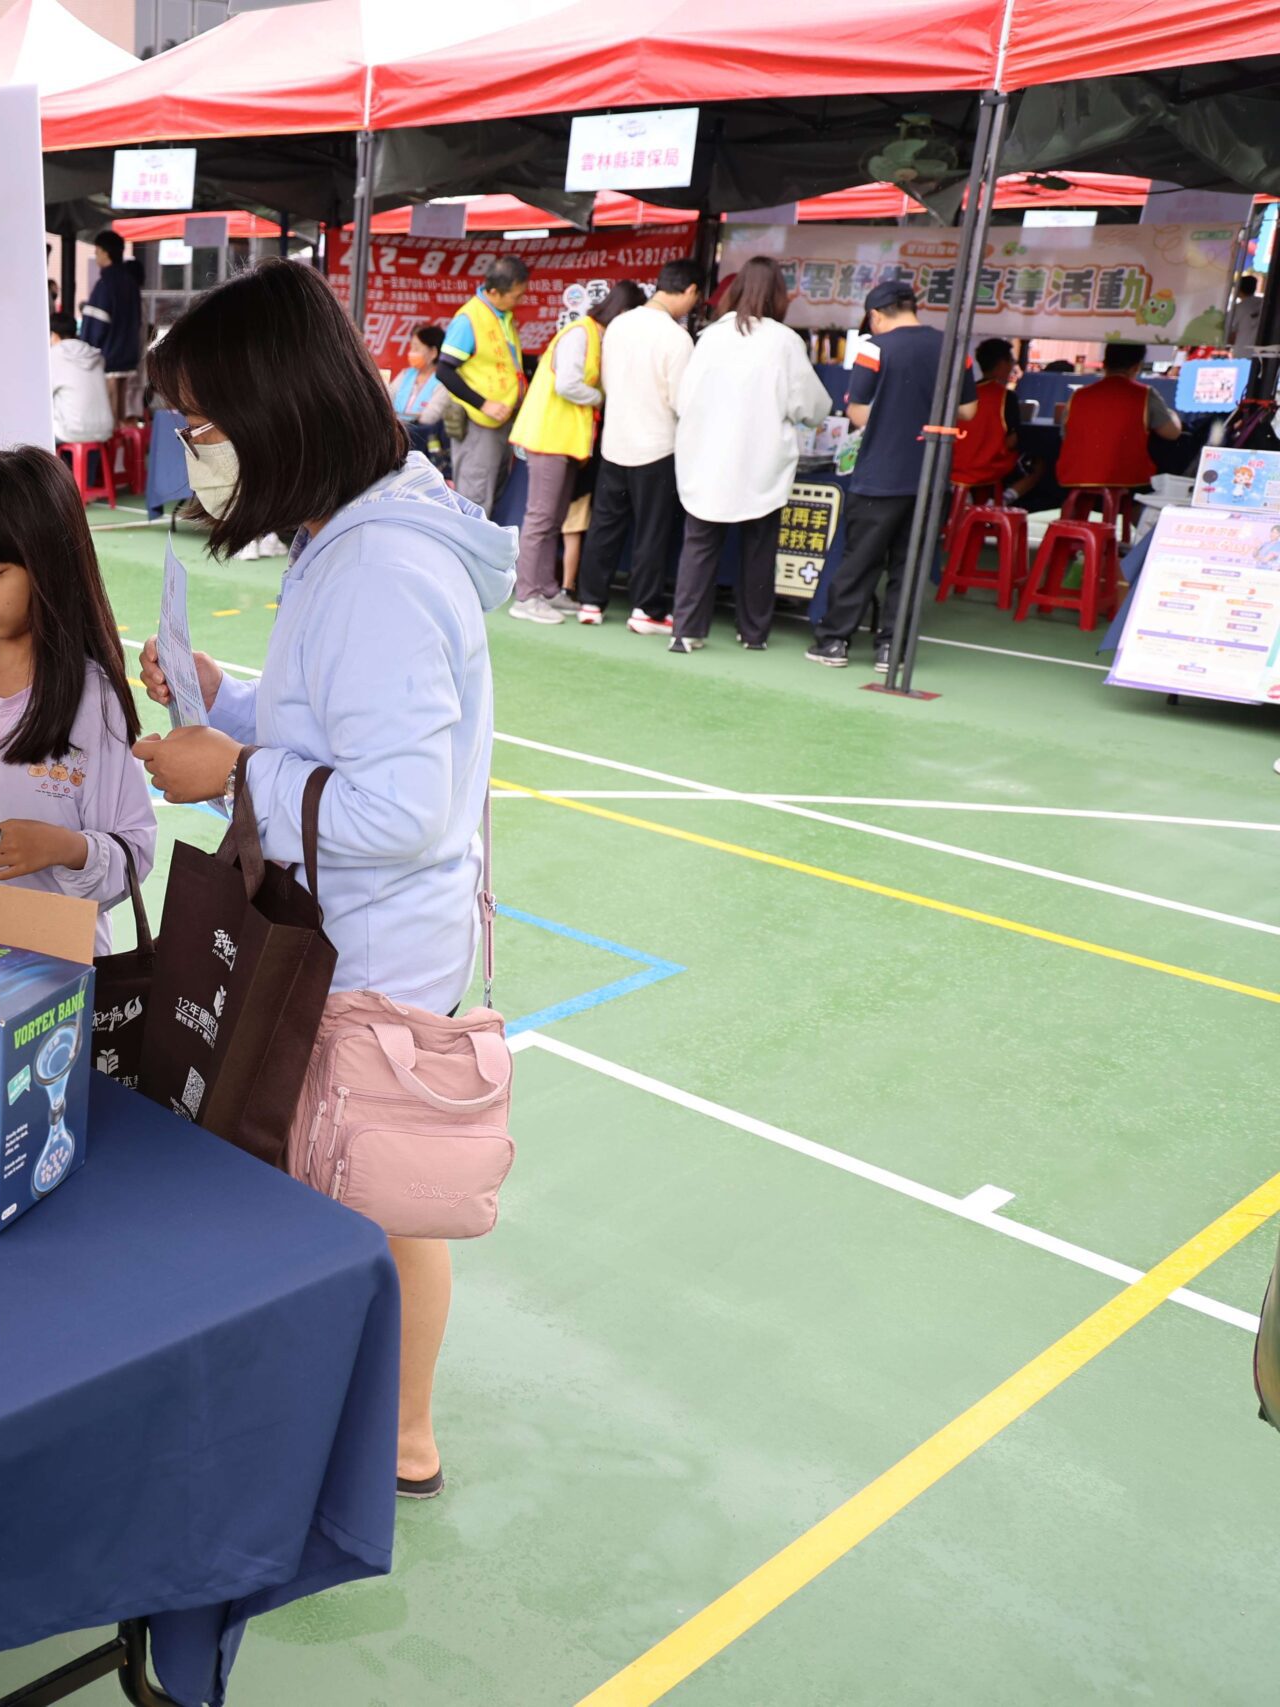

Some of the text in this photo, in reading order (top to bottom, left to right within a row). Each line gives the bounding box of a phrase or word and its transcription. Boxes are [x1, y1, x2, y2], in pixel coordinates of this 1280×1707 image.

[581, 147, 680, 171] 雲林縣環保局
[14, 990, 85, 1050] VORTEX BANK
